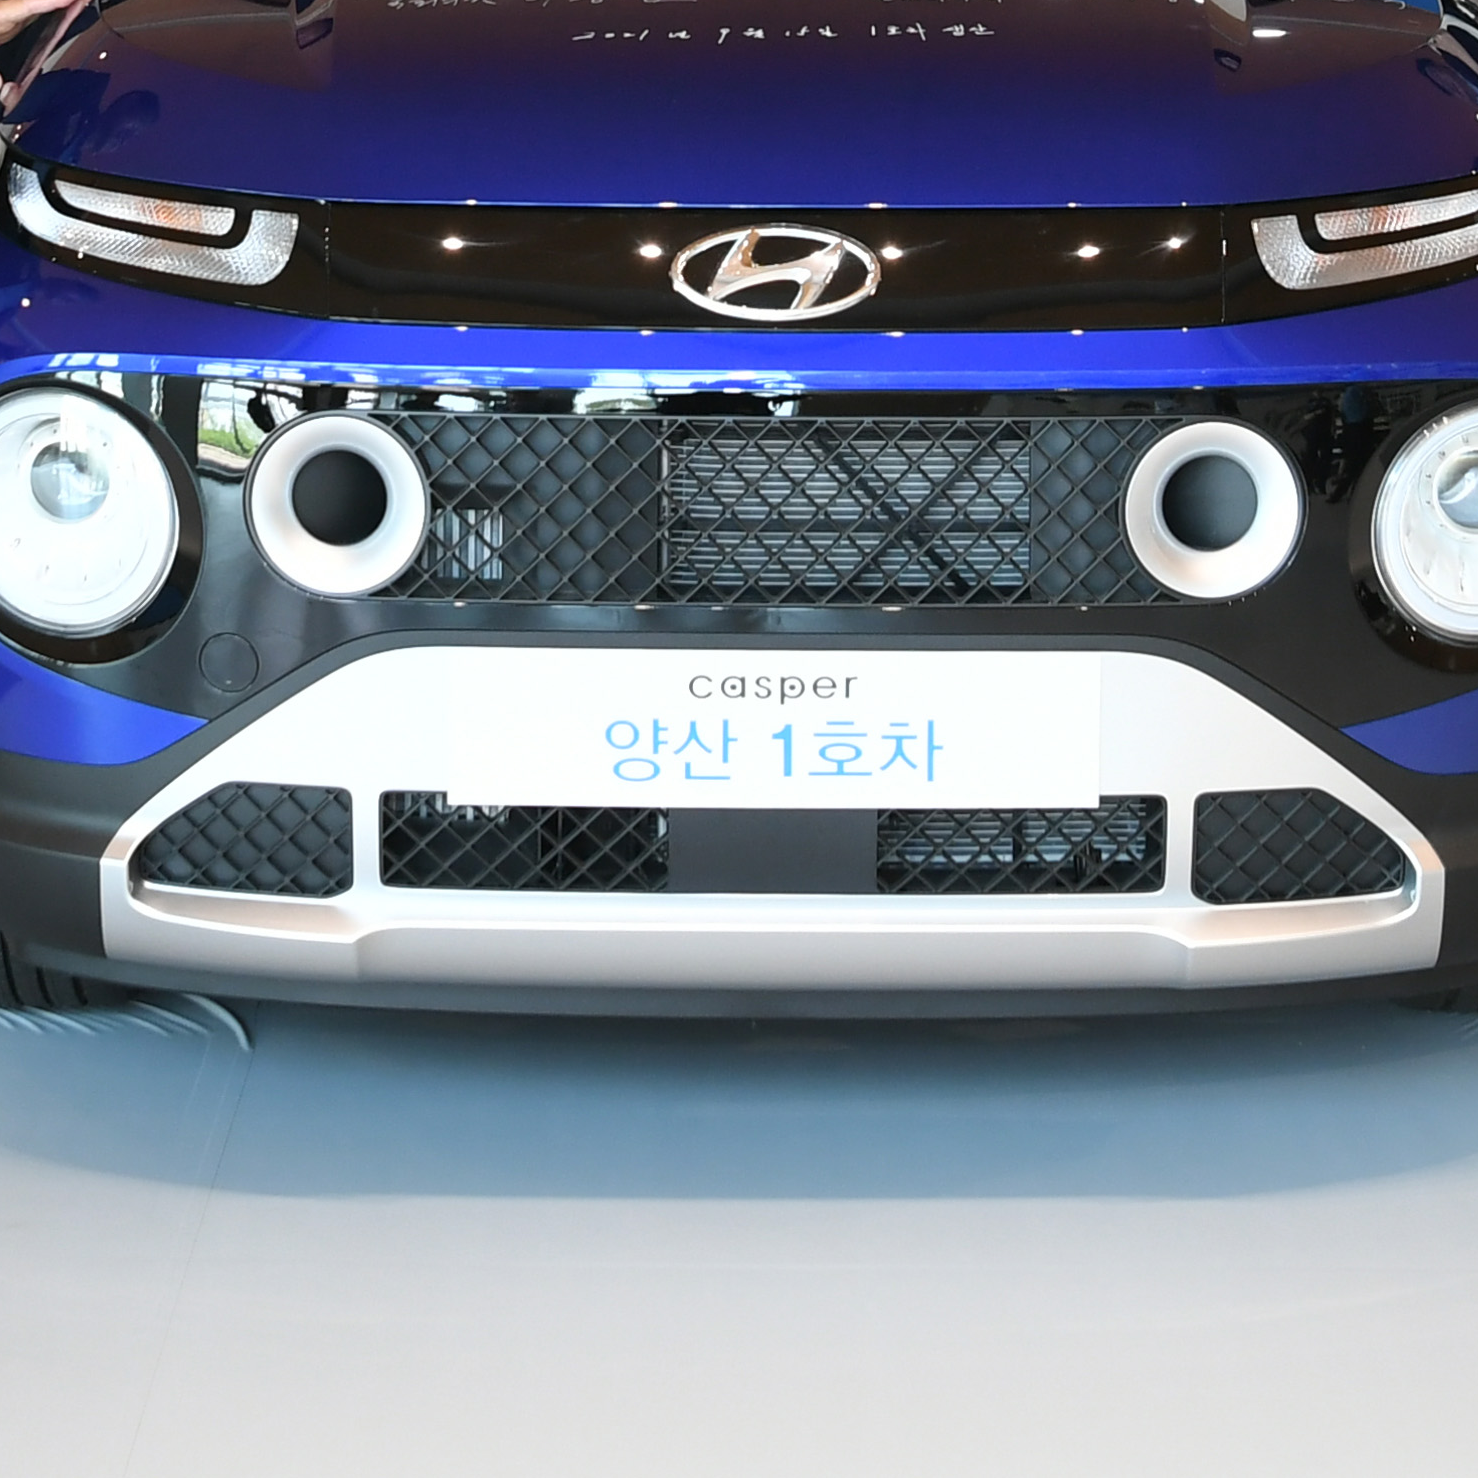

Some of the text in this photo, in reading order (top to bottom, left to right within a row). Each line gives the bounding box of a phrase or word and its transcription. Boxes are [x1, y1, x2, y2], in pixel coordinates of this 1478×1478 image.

[688, 675, 858, 705] casper
[605, 718, 944, 782] 양산 1호차
